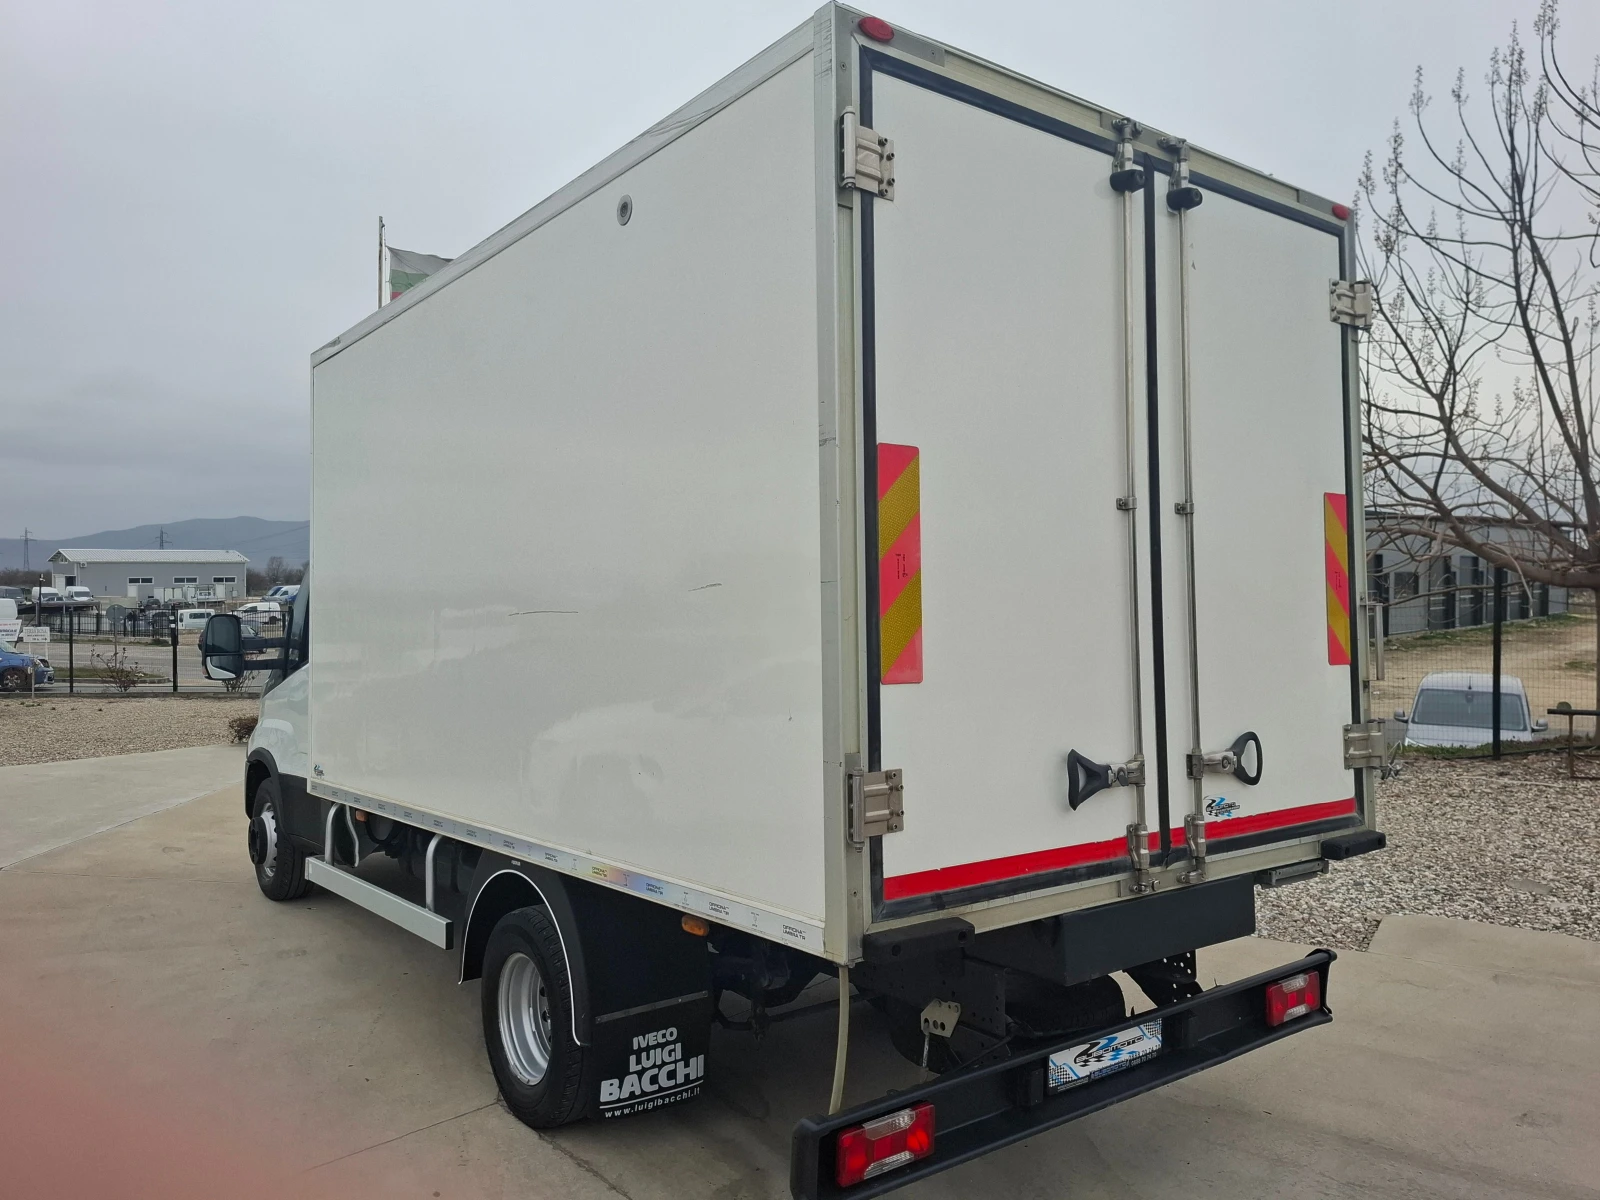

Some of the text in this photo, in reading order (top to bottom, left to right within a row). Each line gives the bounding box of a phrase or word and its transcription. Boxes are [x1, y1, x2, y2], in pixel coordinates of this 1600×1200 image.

[632, 1027, 678, 1050] IVECO
[629, 1042, 682, 1072] LUIGI
[600, 1054, 704, 1102] BACCHI
[605, 1087, 700, 1117] www.luigibacchi.it
